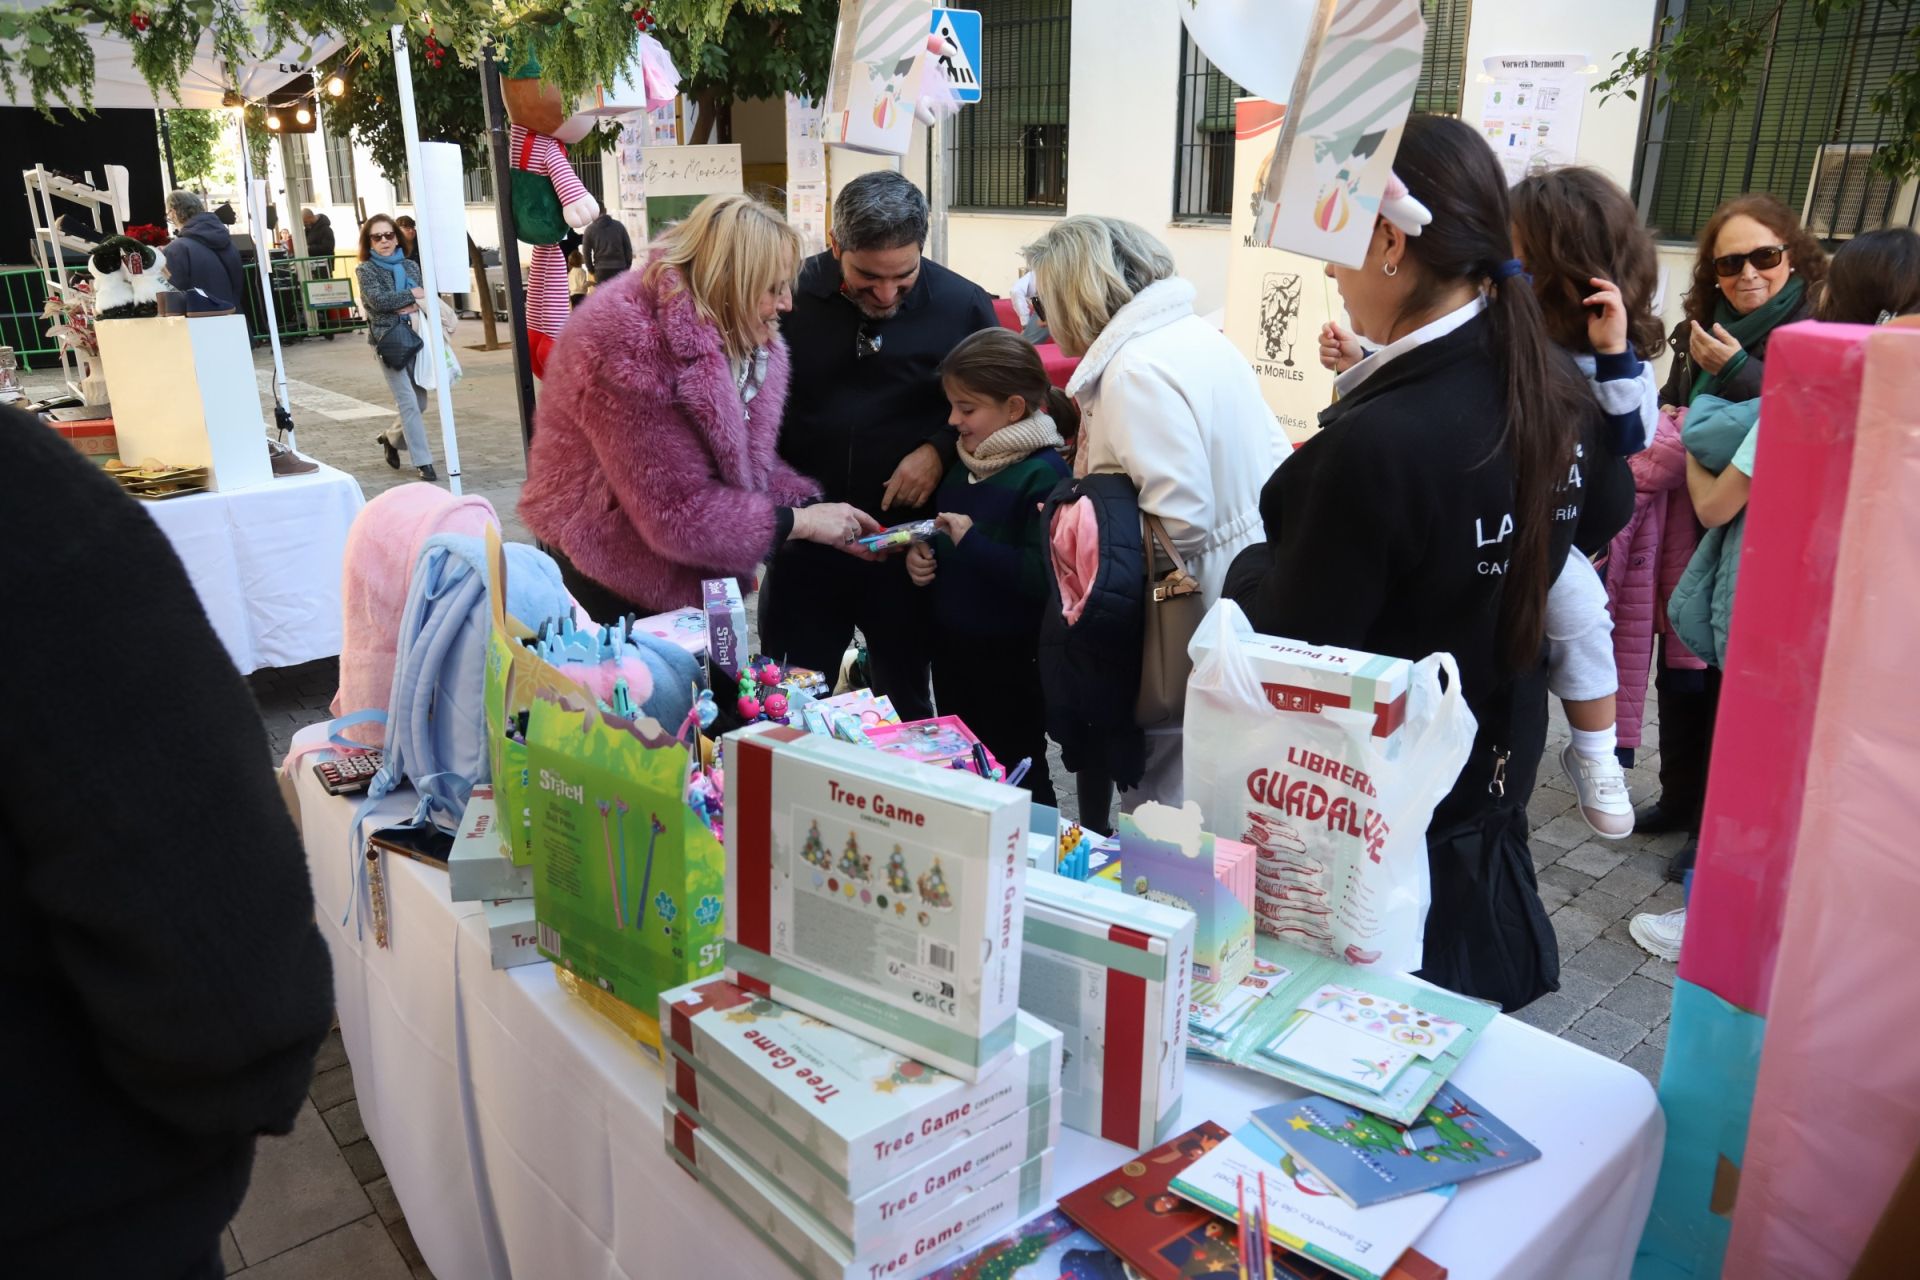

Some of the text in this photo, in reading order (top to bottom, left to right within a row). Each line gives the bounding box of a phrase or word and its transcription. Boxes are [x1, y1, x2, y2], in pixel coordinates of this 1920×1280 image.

[1502, 60, 1565, 69] Vorwerk Thermomix
[465, 814, 491, 840] Memo
[828, 779, 926, 828] Tree Game
[1004, 826, 1021, 880] Tree
[511, 934, 537, 948] Tre
[1001, 886, 1017, 950] Game
[743, 1029, 840, 1104] Tree Game
[873, 1131, 914, 1160] Tree
[920, 1103, 971, 1136] Game
[879, 1190, 918, 1221] Tree
[924, 1160, 972, 1195] Game
[868, 1252, 908, 1280] Tree
[914, 1220, 963, 1257] Game
